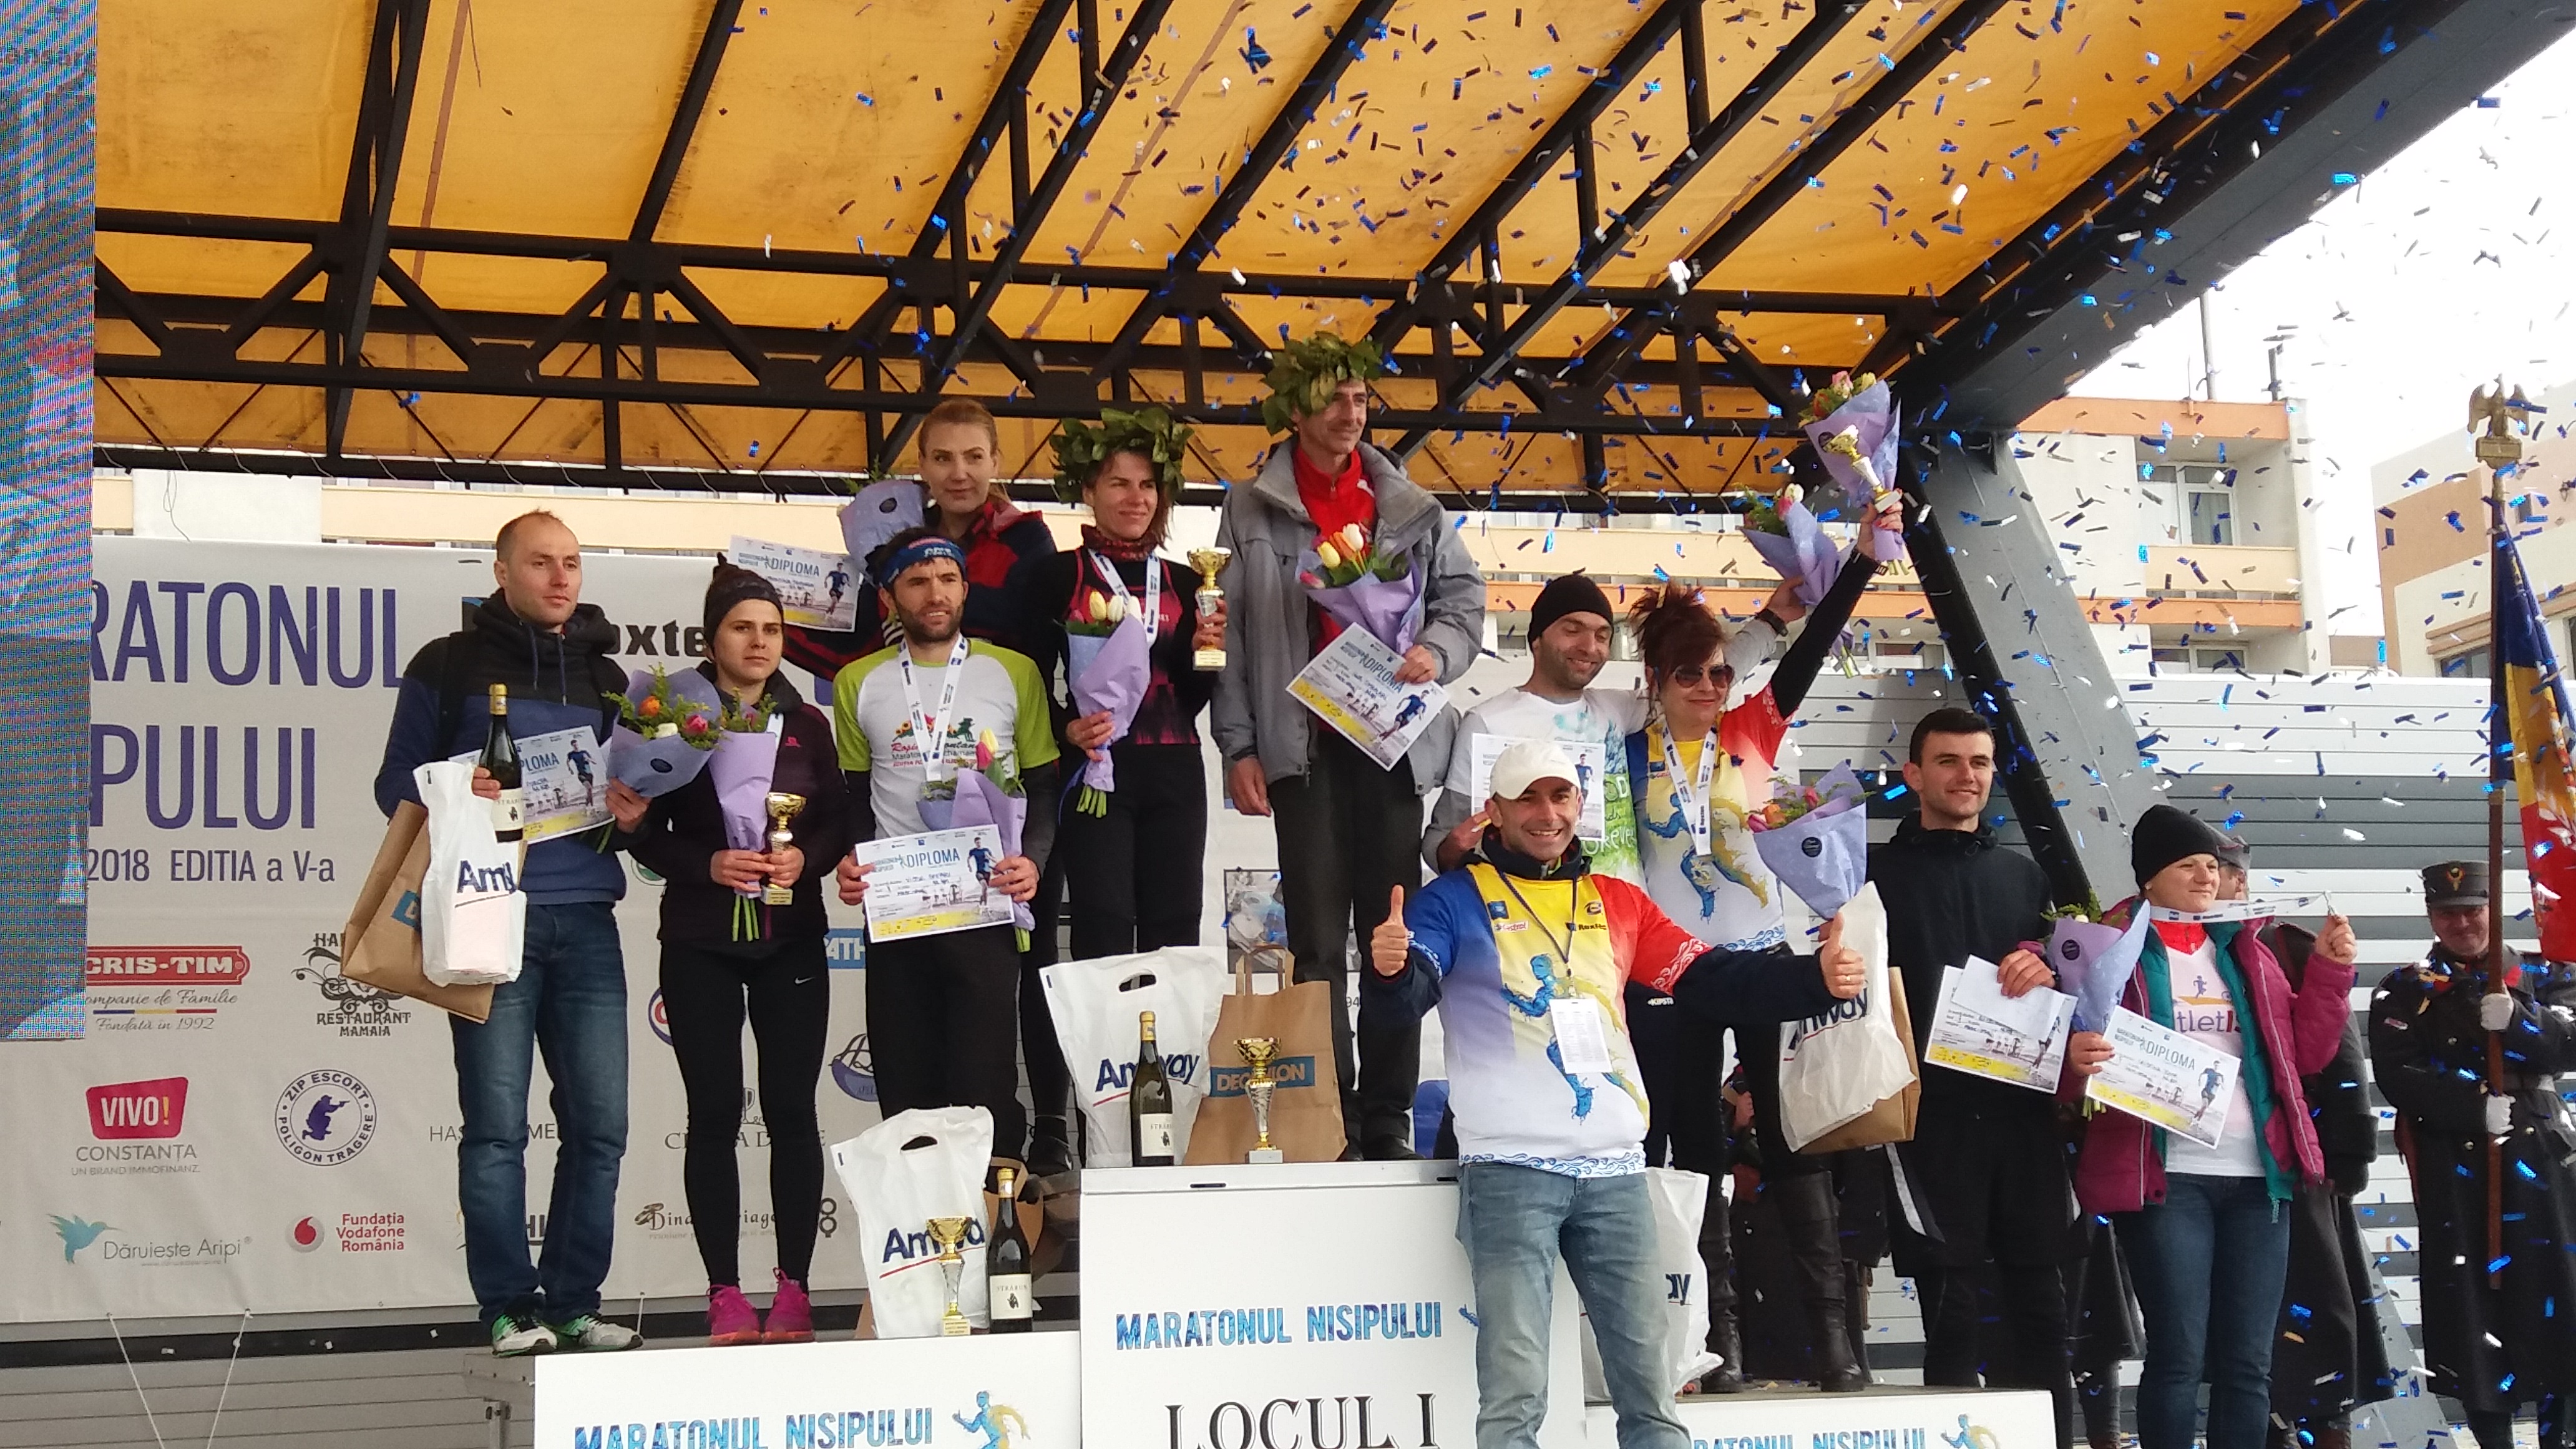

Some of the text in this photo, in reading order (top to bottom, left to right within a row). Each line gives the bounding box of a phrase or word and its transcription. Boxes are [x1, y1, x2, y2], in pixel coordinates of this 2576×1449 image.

[771, 557, 820, 577] DIPLOMA
[1364, 656, 1405, 694] DIPLOMA
[88, 849, 334, 882] 2018 EDITIA a V-a
[907, 847, 960, 868] DIPLOMA
[86, 957, 233, 974] CRIS-TIM
[85, 993, 150, 1008] ompanie
[176, 988, 238, 1005] Familie
[177, 1017, 215, 1030] 1992
[316, 1012, 411, 1025] RESTAURANT
[339, 1026, 391, 1037] MAMAIA
[2145, 1040, 2196, 1070] DIPLOMA
[285, 1071, 369, 1101] ZIP ESCORT
[100, 1096, 170, 1126] VIVO!
[278, 1114, 374, 1163] POLIGON TRAGERE
[71, 1168, 87, 1176] UN
[91, 1166, 125, 1175] BRAND
[336, 1226, 405, 1239] Vodafone
[197, 1238, 241, 1264] Aripi
[341, 1239, 404, 1252] România
[1116, 1302, 1442, 1350] MARATONUL NISIPULUI
[575, 1407, 932, 1449] MARATONUL NISIPULUI
[1164, 1393, 1438, 1449] LOCUL I
